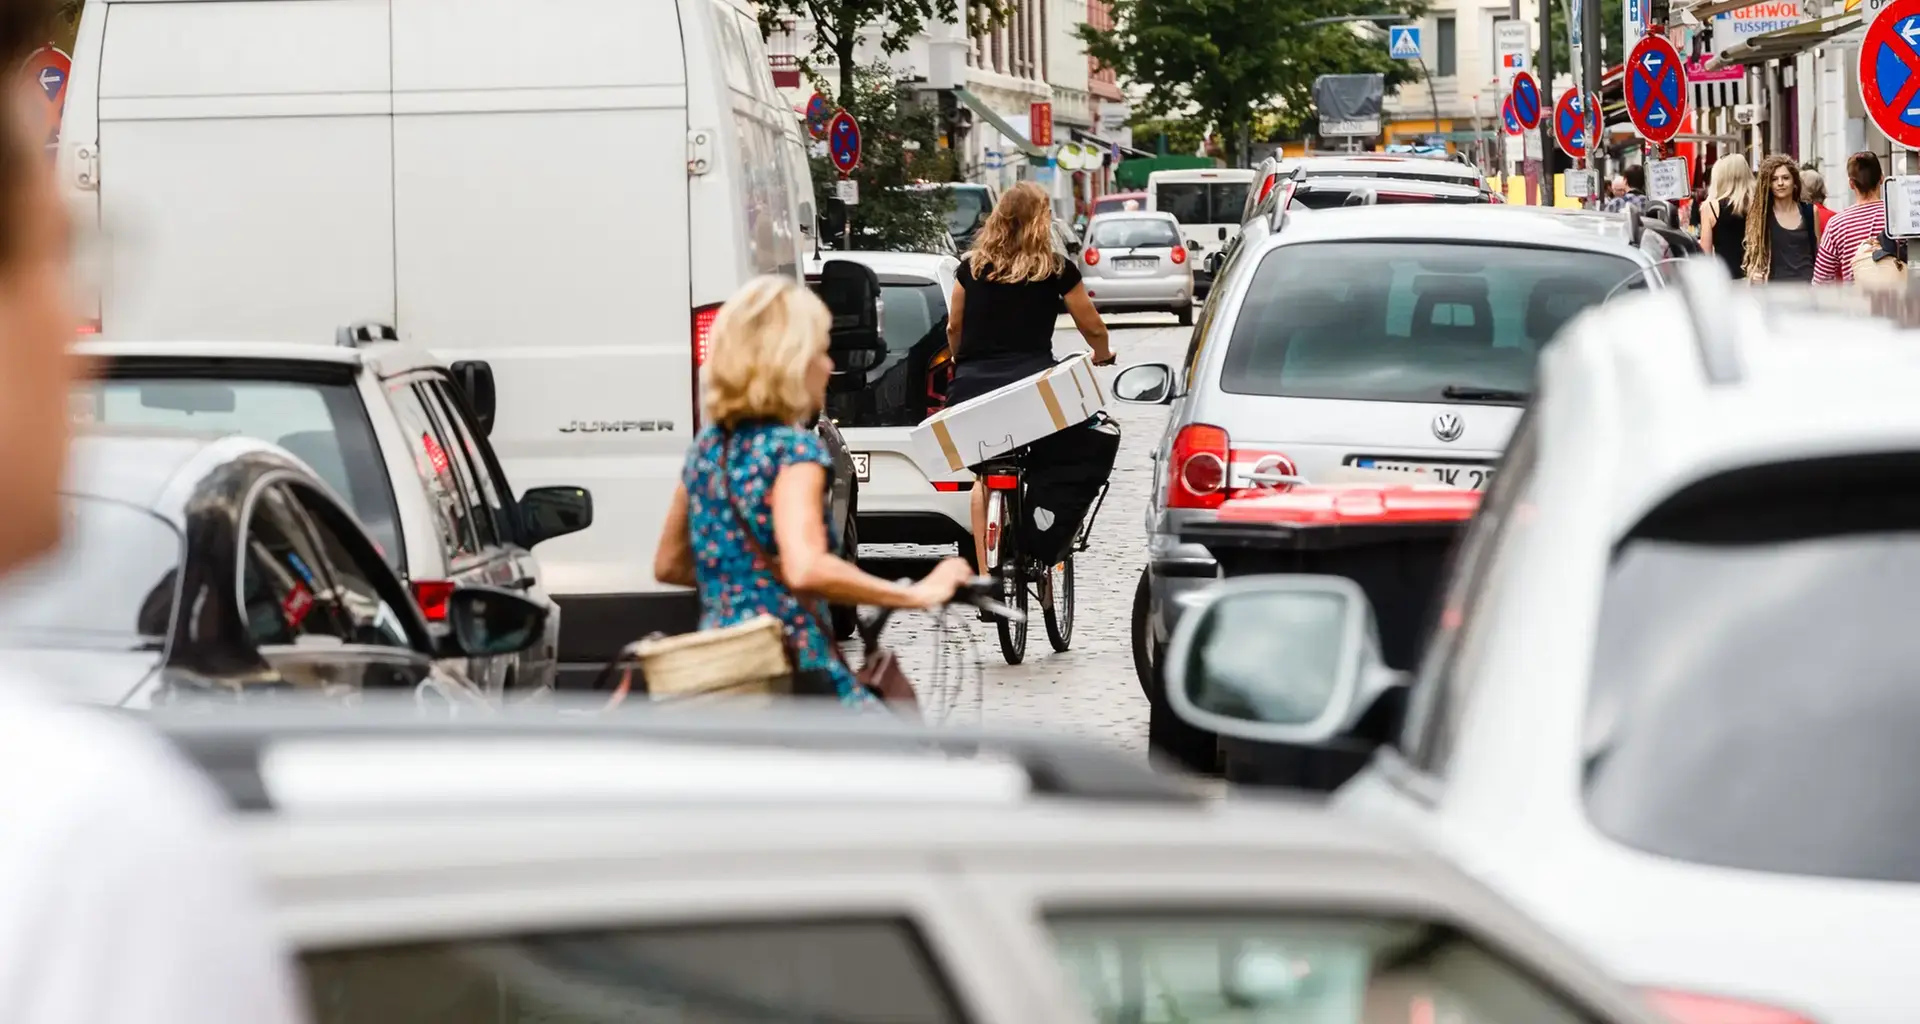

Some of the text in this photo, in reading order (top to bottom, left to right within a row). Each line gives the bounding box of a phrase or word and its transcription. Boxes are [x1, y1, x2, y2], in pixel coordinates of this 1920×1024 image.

[1733, 3, 1800, 19] GEHWOL
[558, 420, 674, 433] JUMPER
[852, 456, 867, 474] 3
